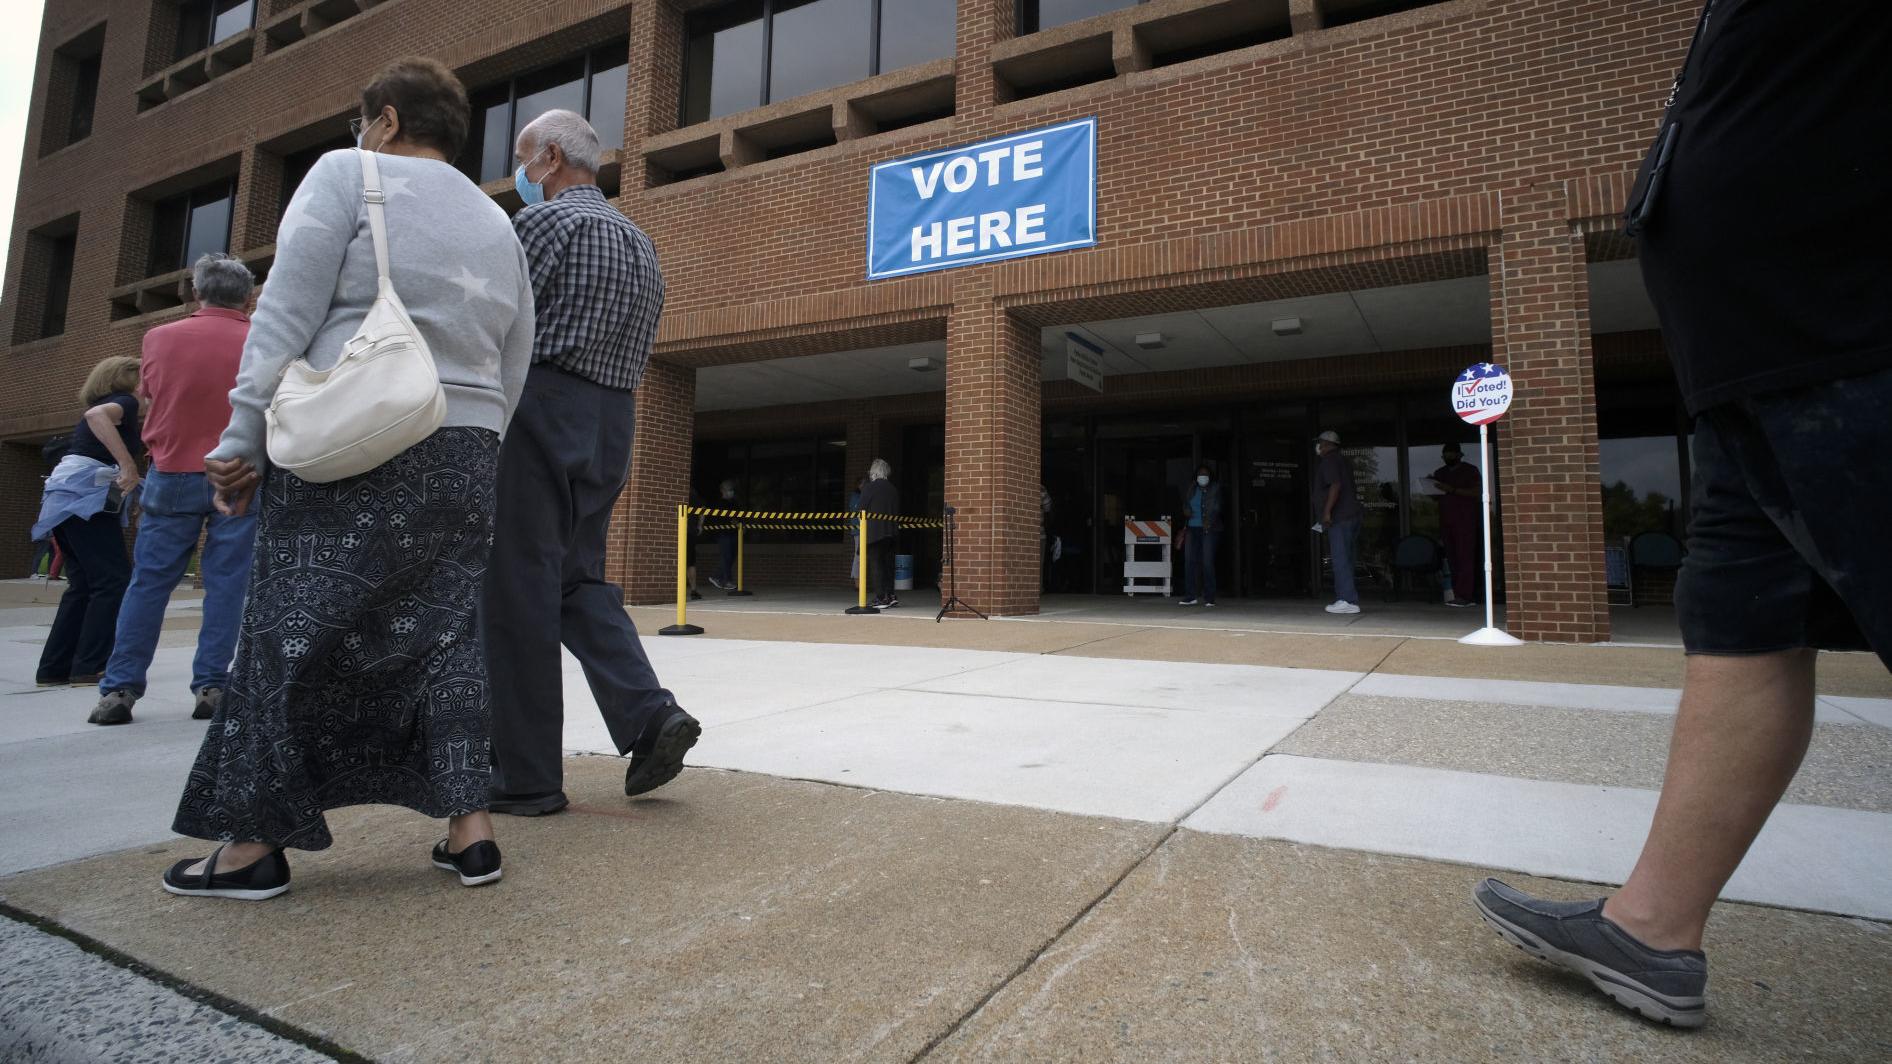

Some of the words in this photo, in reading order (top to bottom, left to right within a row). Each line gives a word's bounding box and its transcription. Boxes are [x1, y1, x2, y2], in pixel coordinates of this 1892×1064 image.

[911, 140, 1043, 200] VOTE
[911, 203, 1046, 262] HERE
[1456, 398, 1476, 410] Did
[1479, 394, 1508, 407] You?
[1457, 386, 1461, 396] I
